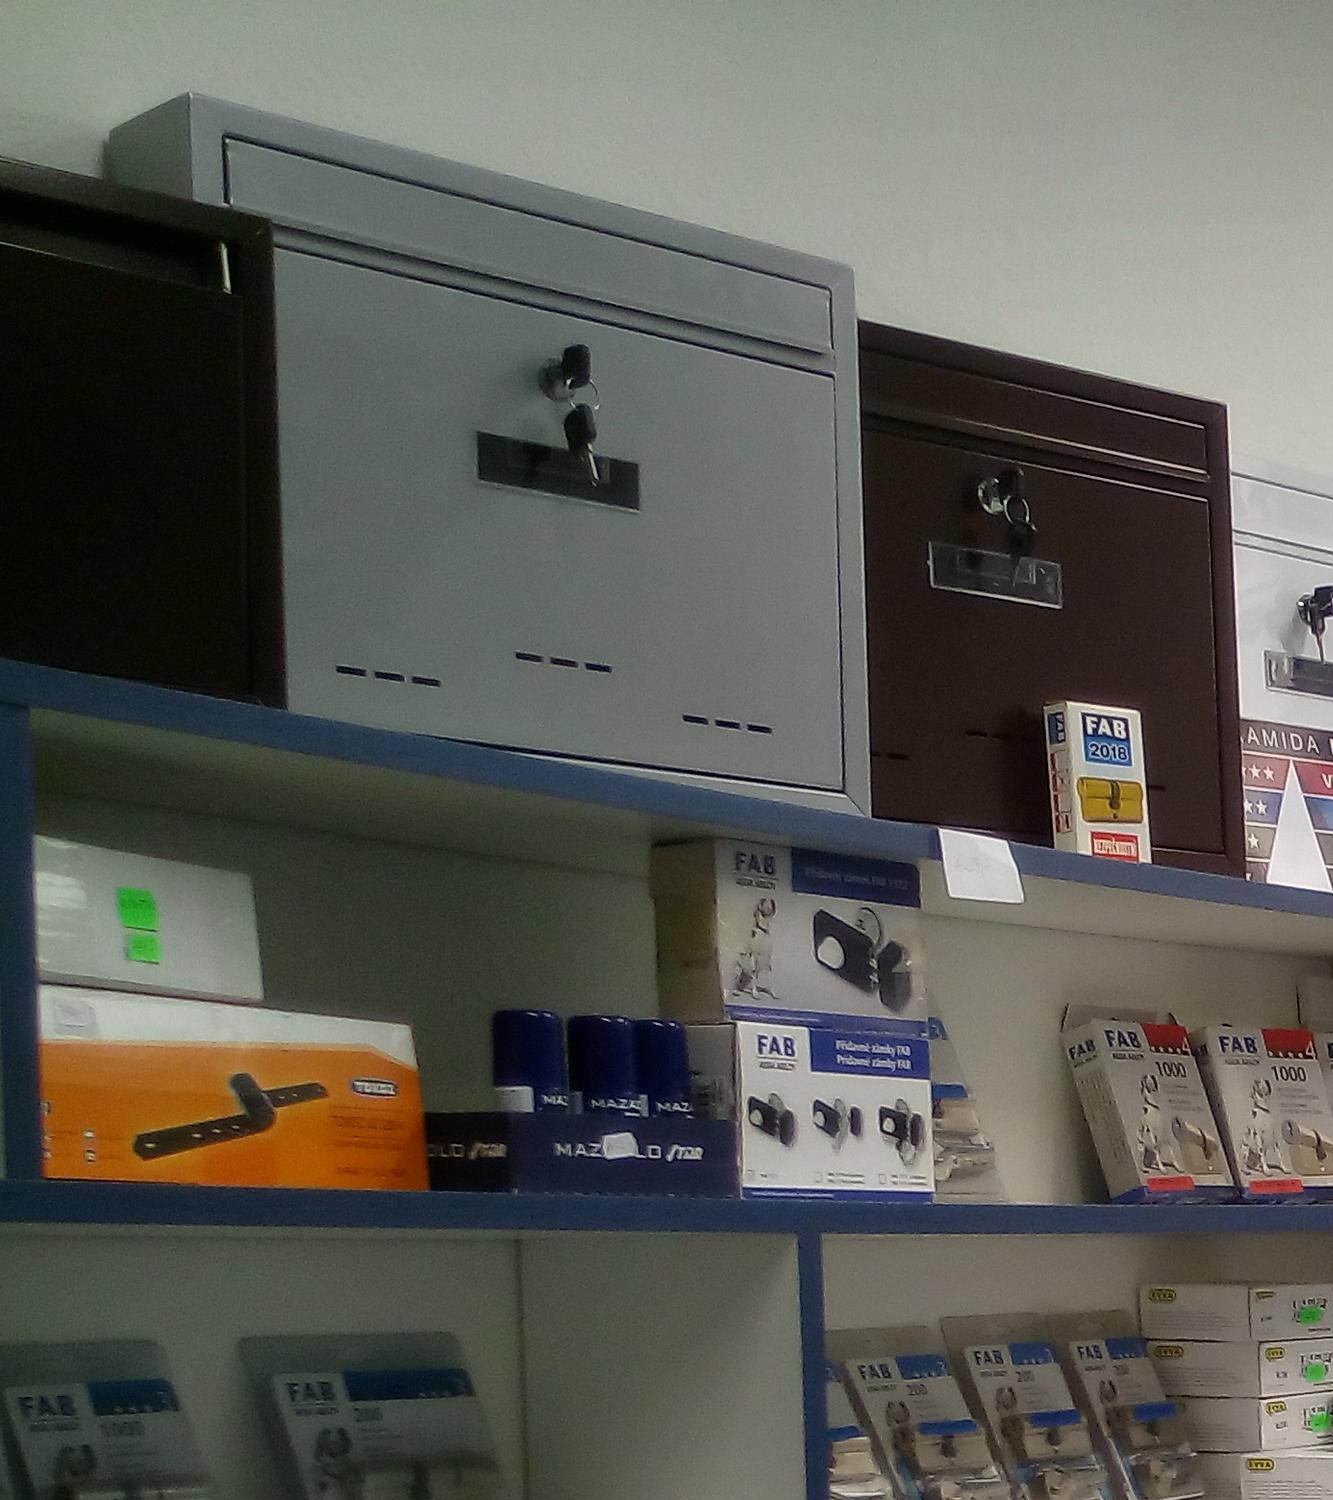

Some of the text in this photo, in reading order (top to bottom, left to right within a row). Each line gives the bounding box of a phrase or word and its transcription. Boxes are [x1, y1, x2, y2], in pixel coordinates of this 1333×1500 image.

[1085, 716, 1127, 740] FAB
[1241, 726, 1320, 754] AMIDA
[1089, 742, 1128, 761] 2018
[735, 851, 776, 875] FAB
[757, 1034, 796, 1057] FAB
[1104, 1029, 1143, 1049] FAB
[1218, 1036, 1258, 1054] FAB
[1305, 1040, 1317, 1059] 4
[1155, 1061, 1187, 1078] 1000
[1271, 1066, 1307, 1082] 1000
[974, 1350, 1004, 1366] FAB
[1077, 1345, 1103, 1360] FAB
[857, 1363, 893, 1380] FAB
[286, 1381, 335, 1402] FAB
[19, 1394, 77, 1417] FAB
